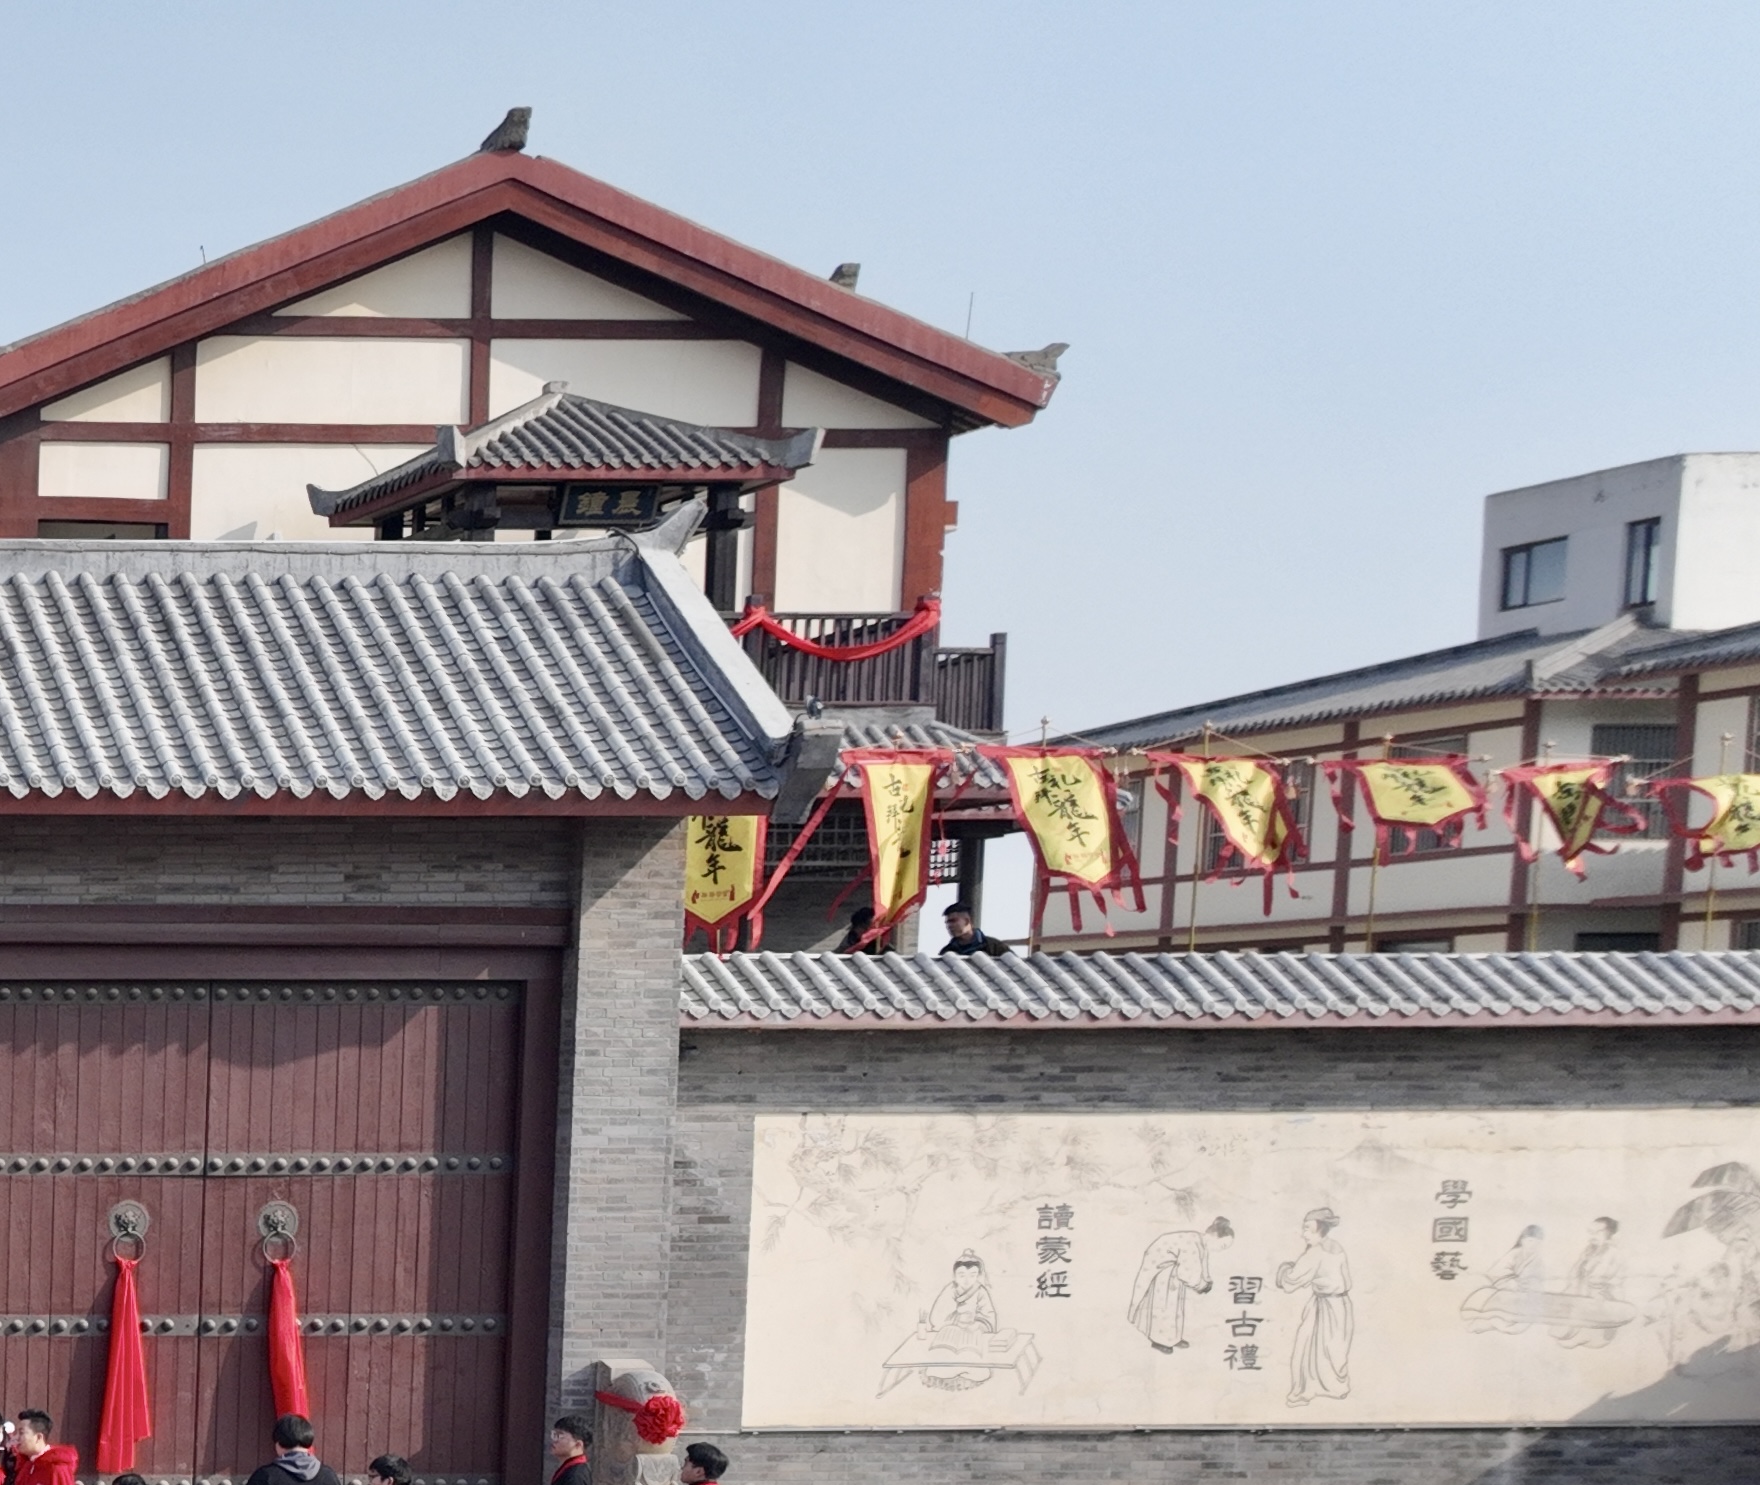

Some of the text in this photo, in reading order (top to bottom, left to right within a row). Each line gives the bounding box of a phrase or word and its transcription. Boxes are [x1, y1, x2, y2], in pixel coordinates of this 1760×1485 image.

[1034, 1202, 1074, 1299] 讀蒙經
[1223, 1275, 1264, 1371] 習古禮
